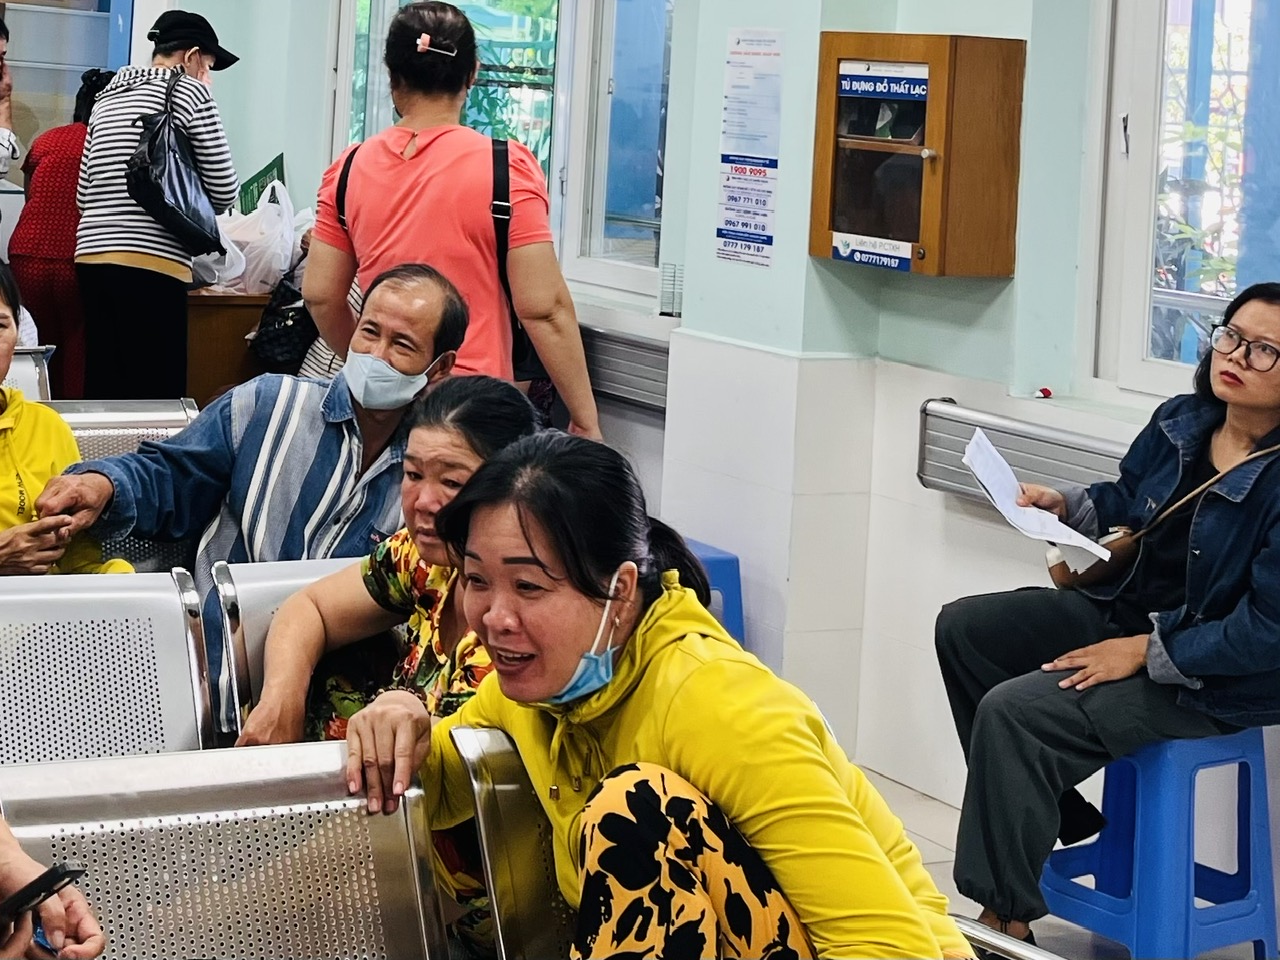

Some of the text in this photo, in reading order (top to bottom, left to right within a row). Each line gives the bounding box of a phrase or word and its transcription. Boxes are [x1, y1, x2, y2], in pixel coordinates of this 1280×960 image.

[890, 80, 909, 94] THẤT
[910, 85, 927, 97] LẠC
[730, 166, 767, 177] 1900 9095
[727, 195, 741, 203] 0967
[755, 198, 766, 206] 010
[754, 224, 766, 232] 010
[723, 240, 738, 249] 0777
[740, 242, 751, 251] 179
